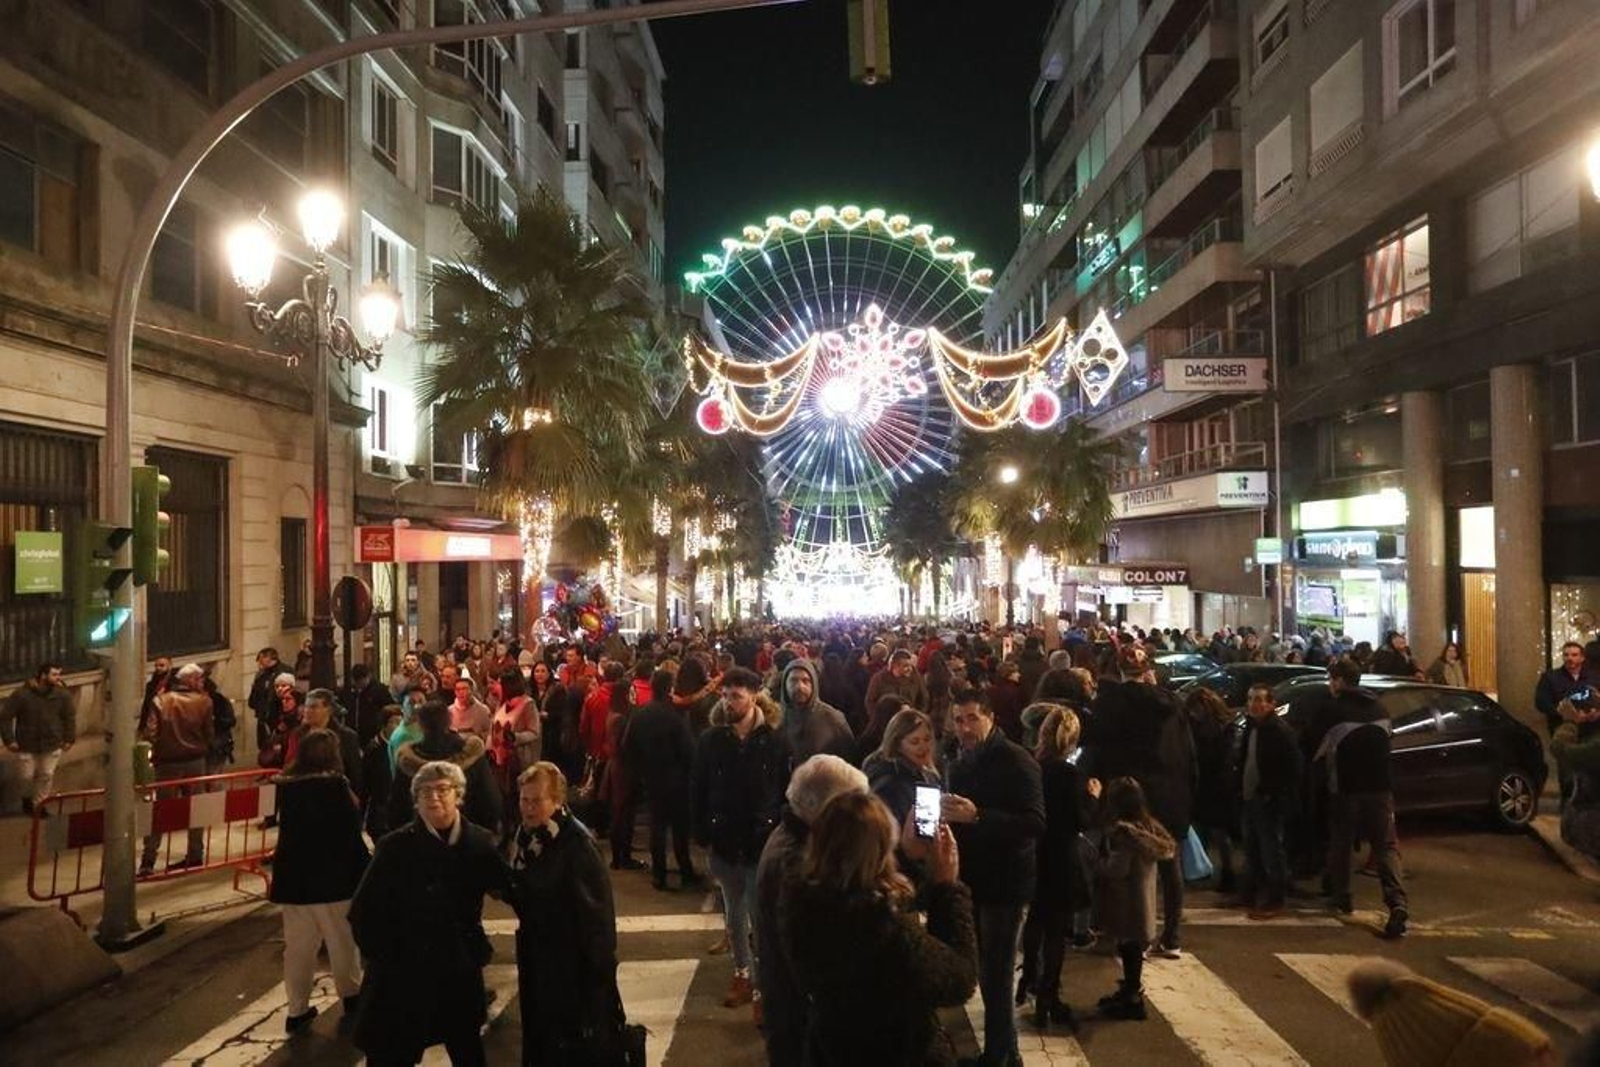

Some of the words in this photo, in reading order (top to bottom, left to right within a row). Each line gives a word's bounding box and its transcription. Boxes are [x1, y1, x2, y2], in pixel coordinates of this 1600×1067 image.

[1185, 364, 1247, 377] DACHSER
[1129, 483, 1174, 506] PREVENTIVA
[1220, 491, 1266, 499] PREVENTIVA
